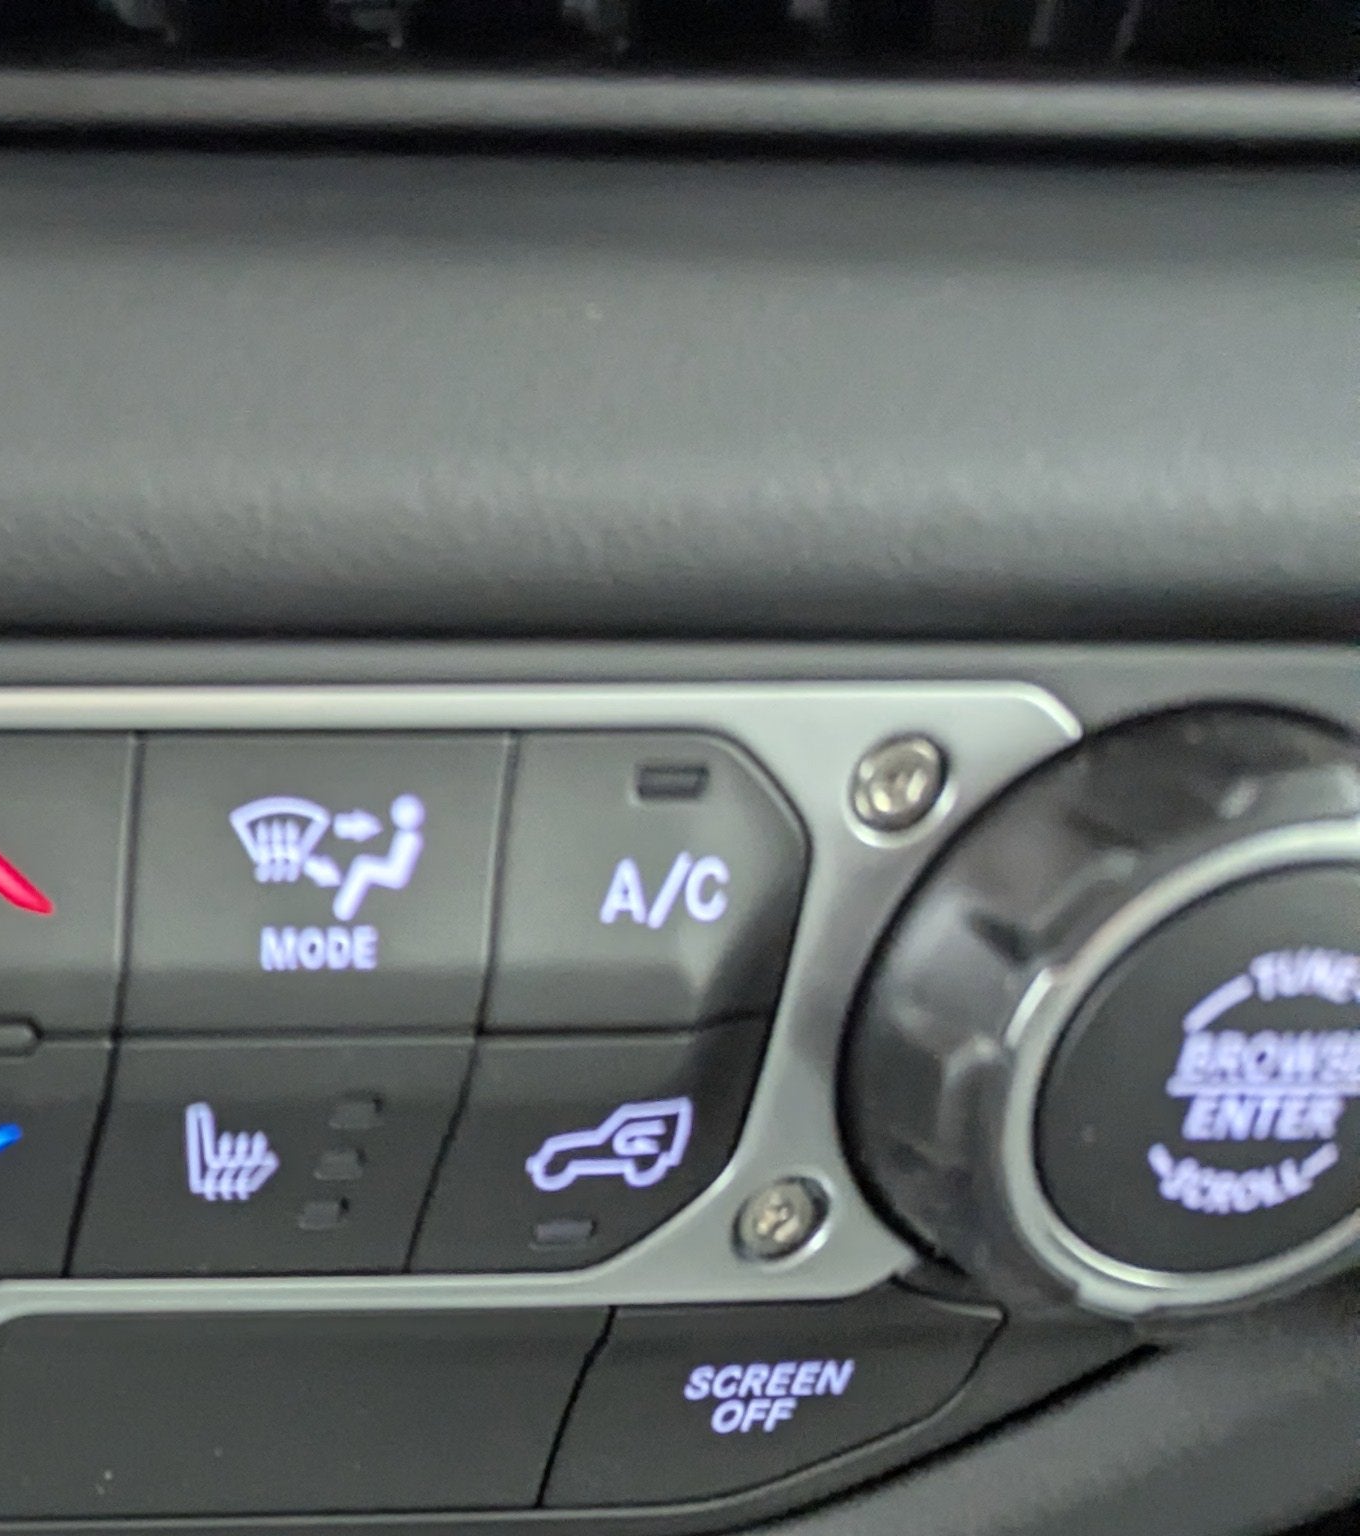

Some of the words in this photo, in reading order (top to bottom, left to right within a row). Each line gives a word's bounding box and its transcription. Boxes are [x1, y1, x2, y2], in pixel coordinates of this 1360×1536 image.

[599, 852, 730, 929] A/C
[259, 924, 379, 971] MODE
[1183, 1096, 1345, 1140] ENTER
[683, 1357, 856, 1400] SCREEN
[710, 1399, 798, 1434] OFF
